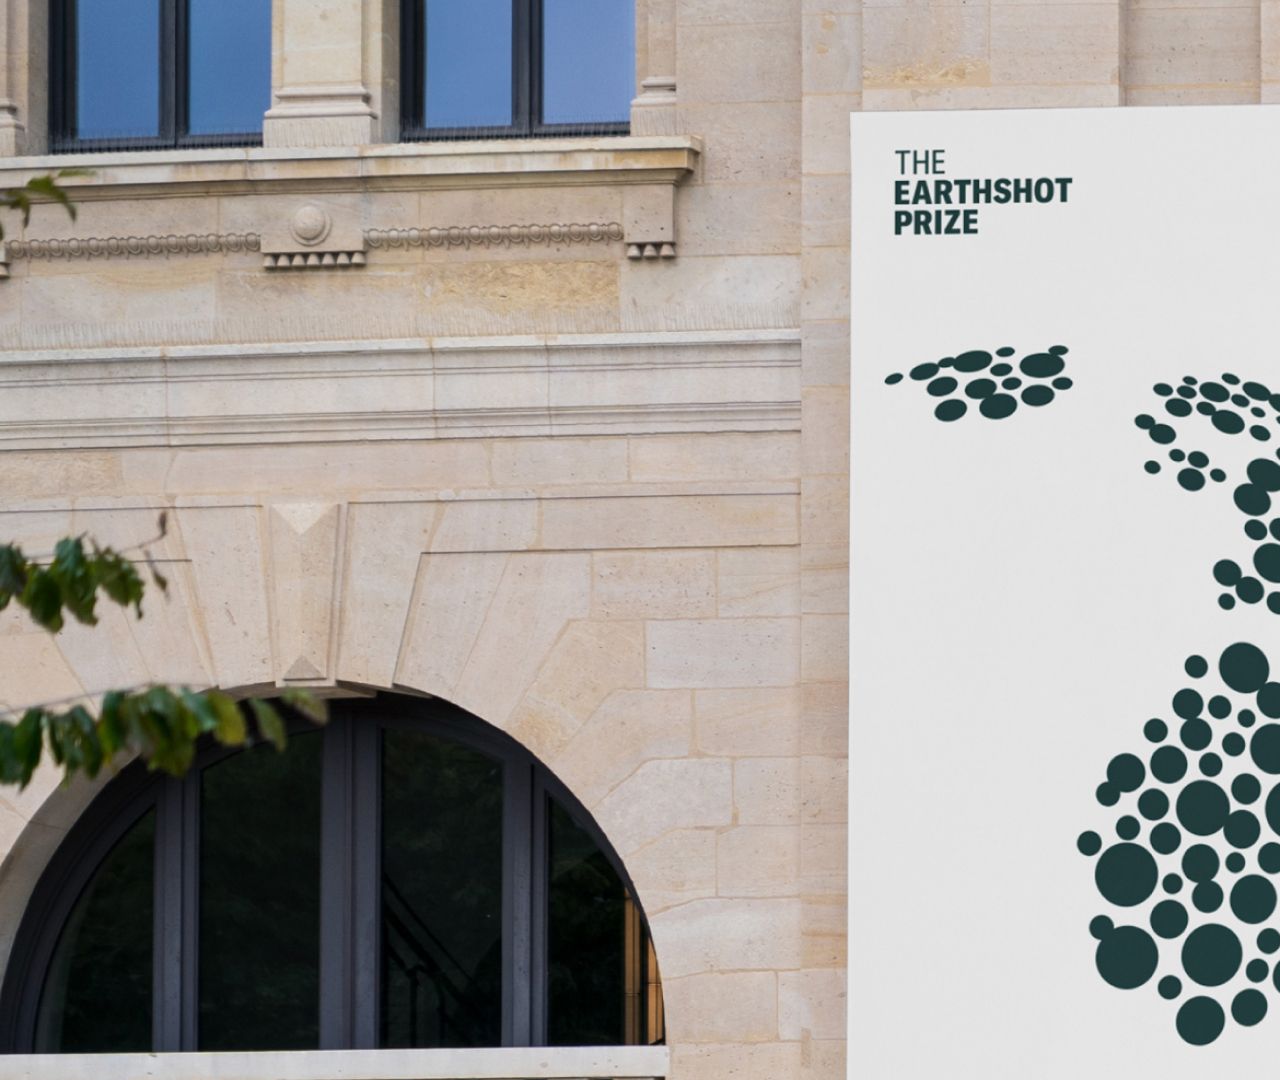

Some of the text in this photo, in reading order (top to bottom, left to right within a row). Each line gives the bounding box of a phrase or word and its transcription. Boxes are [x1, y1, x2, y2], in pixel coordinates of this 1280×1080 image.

[894, 149, 946, 175] THE
[894, 177, 1073, 205] EARTHSHOT
[894, 209, 979, 236] PRIZE
